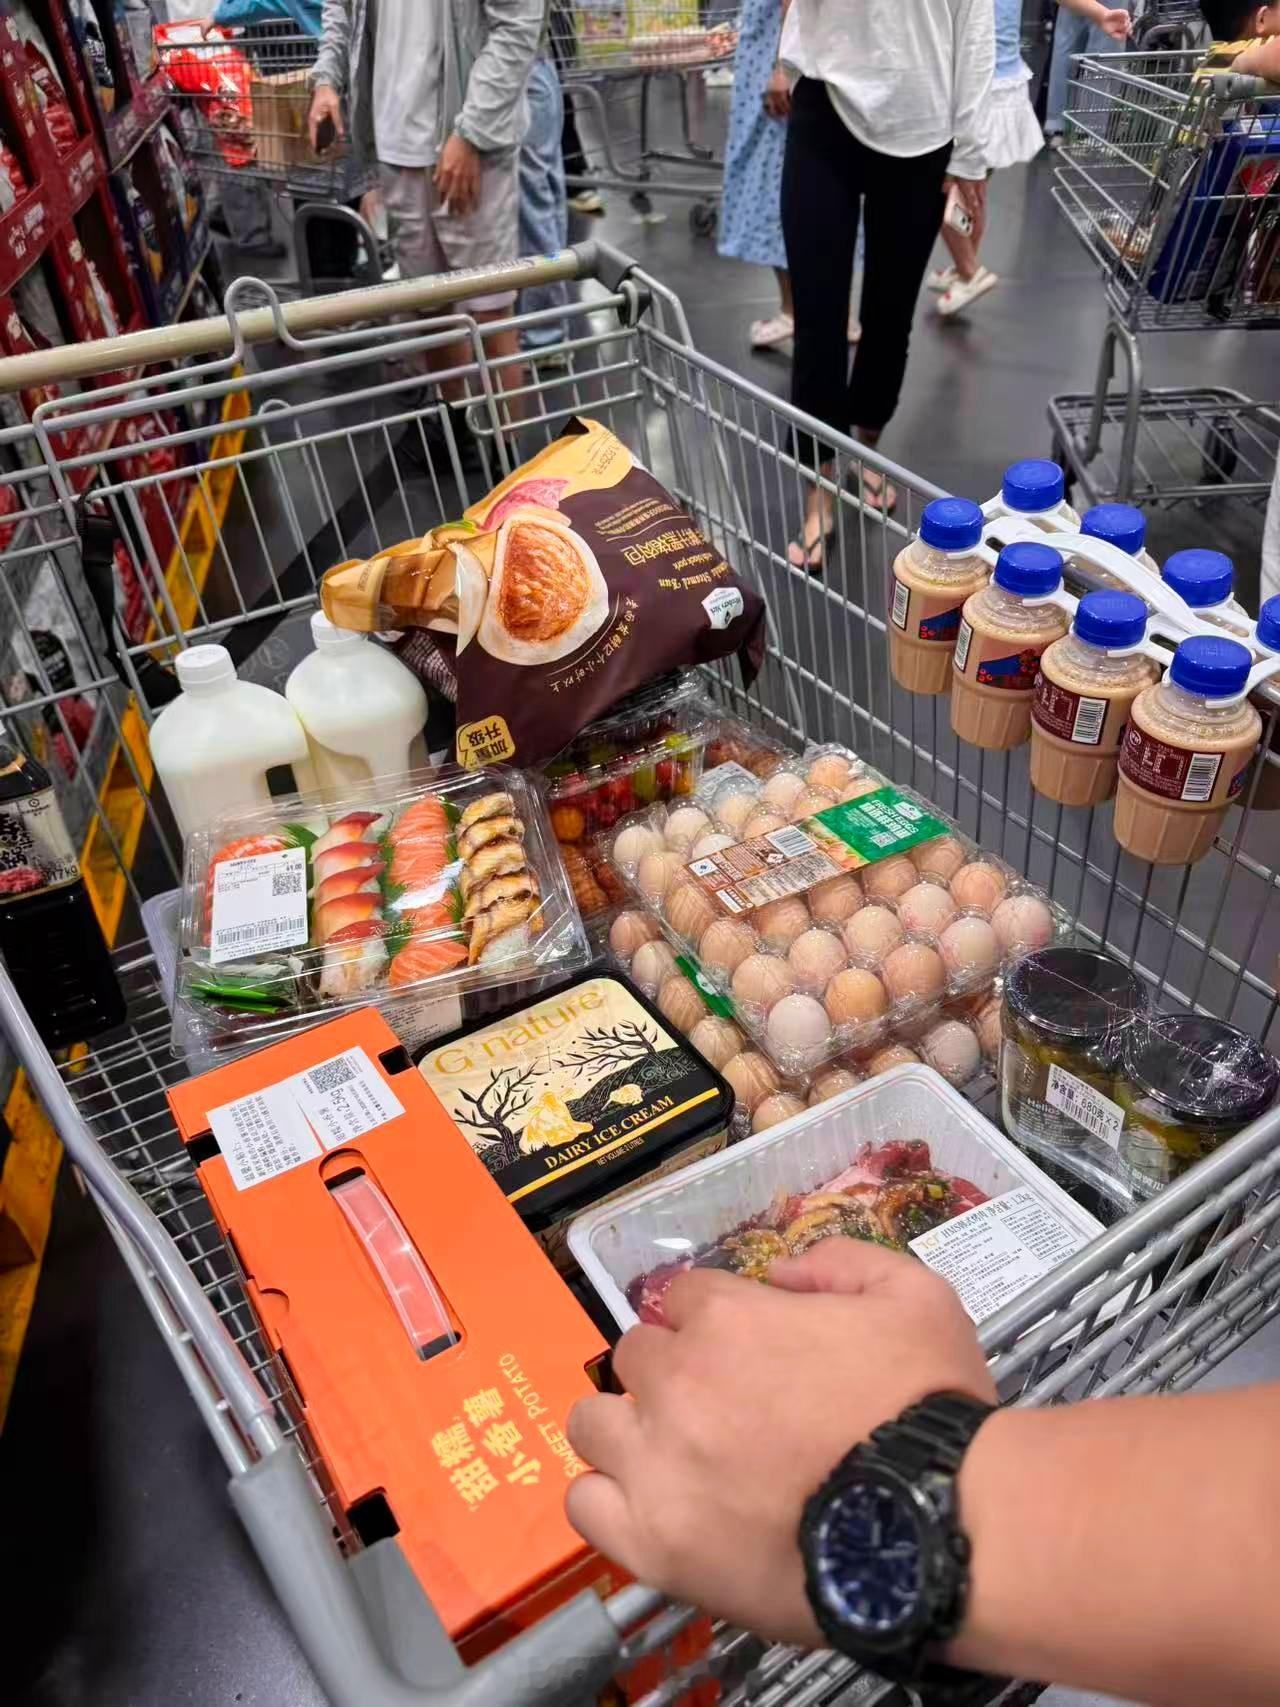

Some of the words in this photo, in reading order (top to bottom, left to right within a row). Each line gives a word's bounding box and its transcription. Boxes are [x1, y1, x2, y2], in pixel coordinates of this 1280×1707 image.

[658, 577, 682, 590] Bun
[466, 722, 502, 746] 升级
[871, 799, 898, 819] FRESH
[894, 814, 919, 834] EGGS
[544, 1138, 594, 1170] DAIRY
[593, 1124, 622, 1145] ICE
[620, 1095, 675, 1130] CREAM
[499, 1353, 549, 1419] POTATO
[463, 1387, 541, 1485] 小香薯
[538, 1420, 585, 1478] SWEET
